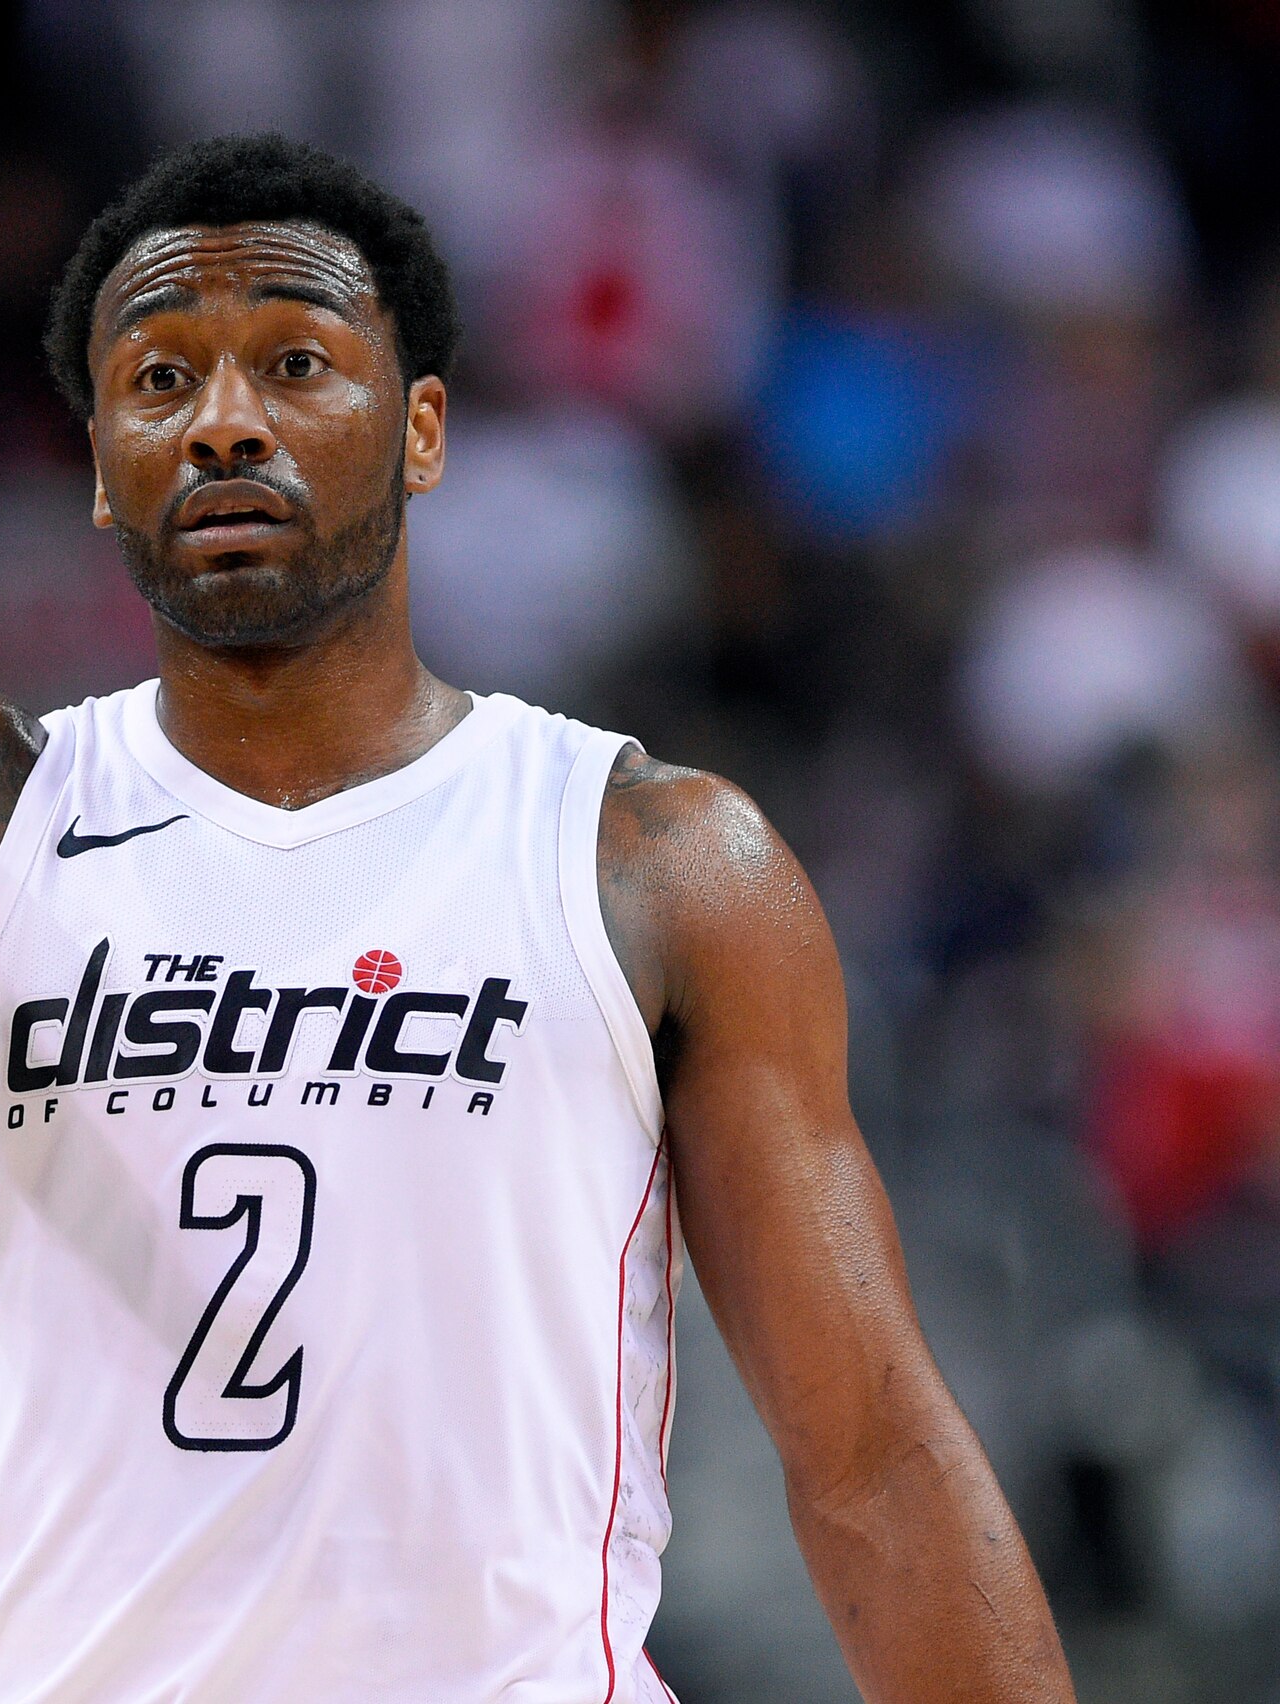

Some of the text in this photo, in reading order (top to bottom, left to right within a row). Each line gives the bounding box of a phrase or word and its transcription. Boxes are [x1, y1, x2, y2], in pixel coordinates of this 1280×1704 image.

[7, 936, 528, 1093] district
[143, 953, 224, 982] THE
[8, 1082, 495, 1130] OF COLUMBIA
[162, 1143, 317, 1452] 2
